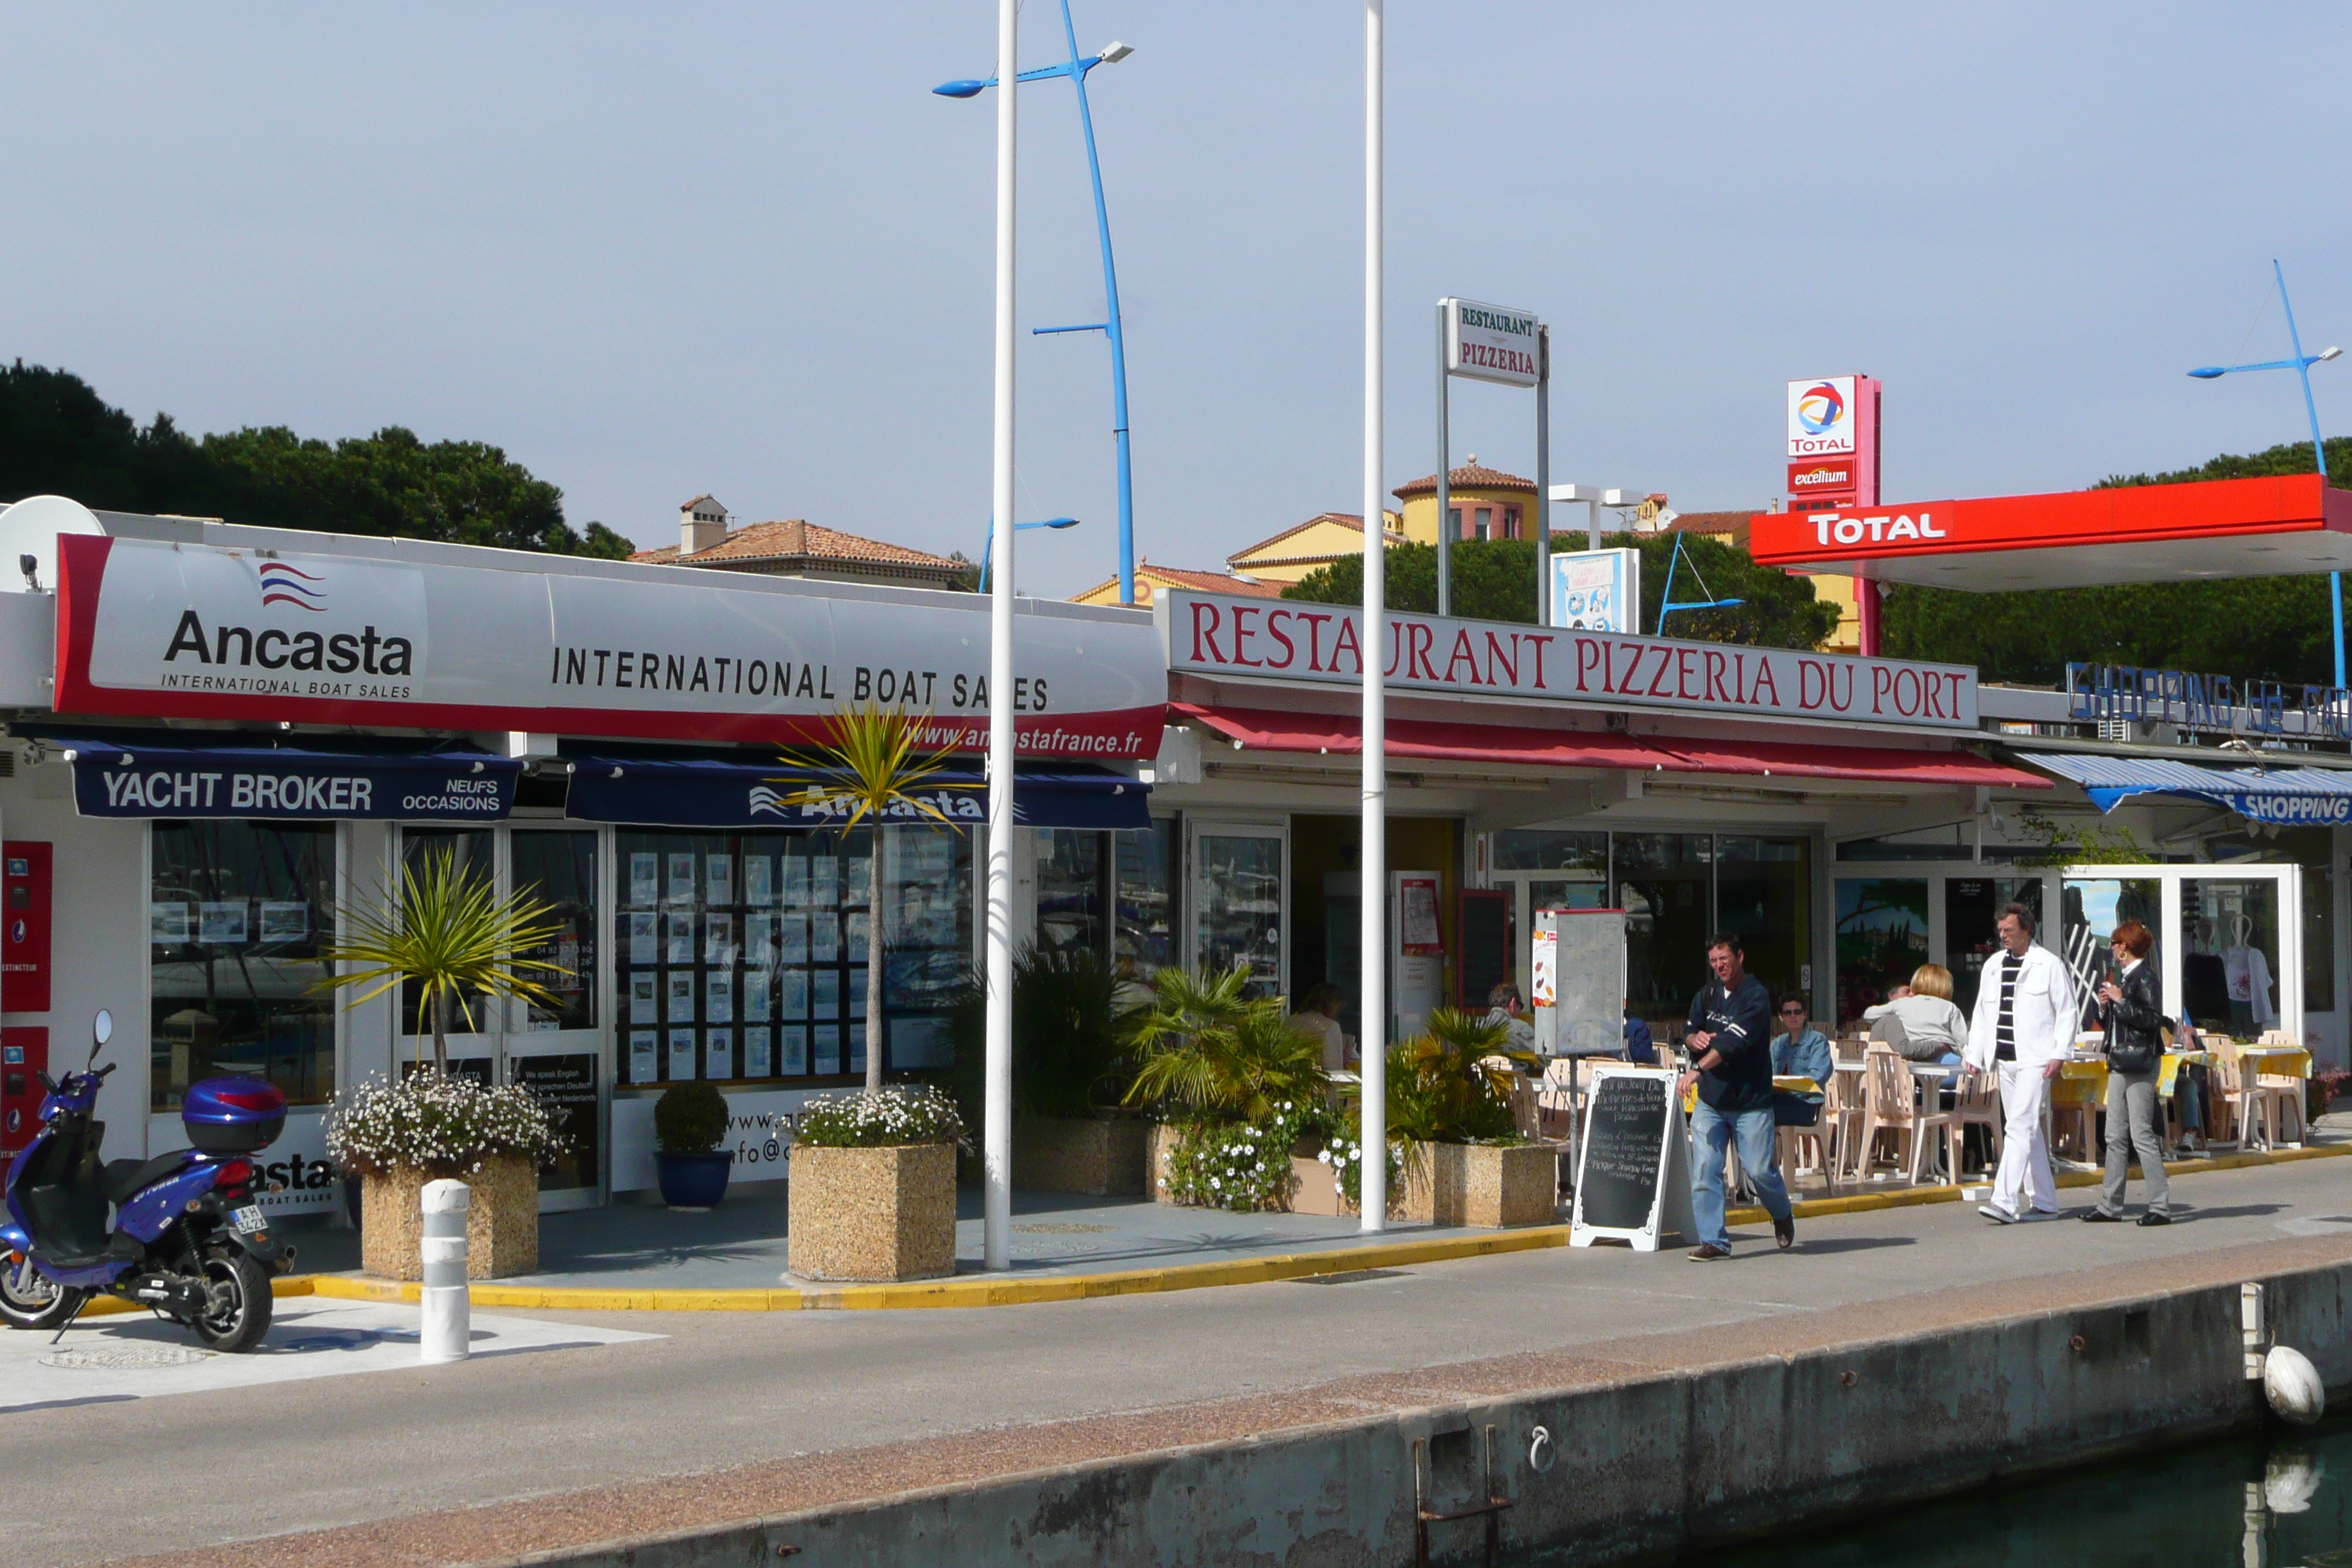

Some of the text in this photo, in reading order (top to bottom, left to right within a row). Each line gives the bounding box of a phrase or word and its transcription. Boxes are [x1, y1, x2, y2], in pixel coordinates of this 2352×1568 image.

[1462, 308, 1533, 336] RESTAURANT
[1462, 342, 1535, 374] PIZZERIA
[1791, 437, 1851, 453] TOTAL
[1795, 470, 1847, 486] excellium
[1808, 513, 1946, 546] TOTAL
[163, 610, 412, 676] Ancasta
[1189, 601, 1968, 720] RESTAURANT PIZZERIA DU PORT
[161, 674, 411, 698] INTERNATIONAL BOAT SALES
[552, 647, 1049, 712] INTERNATIONAL BOAT SAES
[905, 725, 1142, 753] www.anstafrance.fr
[103, 772, 372, 812] YACHT BROKER
[446, 780, 498, 795] NEUFS
[402, 795, 500, 812] OCCASIONS
[2245, 794, 2350, 819] SHOPPING
[1, 964, 37, 972] EXTINCTEUR
[538, 1071, 556, 1080] speak
[557, 1070, 580, 1079] English
[567, 1082, 592, 1090] Deutsch
[260, 1193, 333, 1206] BOAT SALES
[240, 1207, 259, 1220] AH
[238, 1217, 267, 1235] 342X
